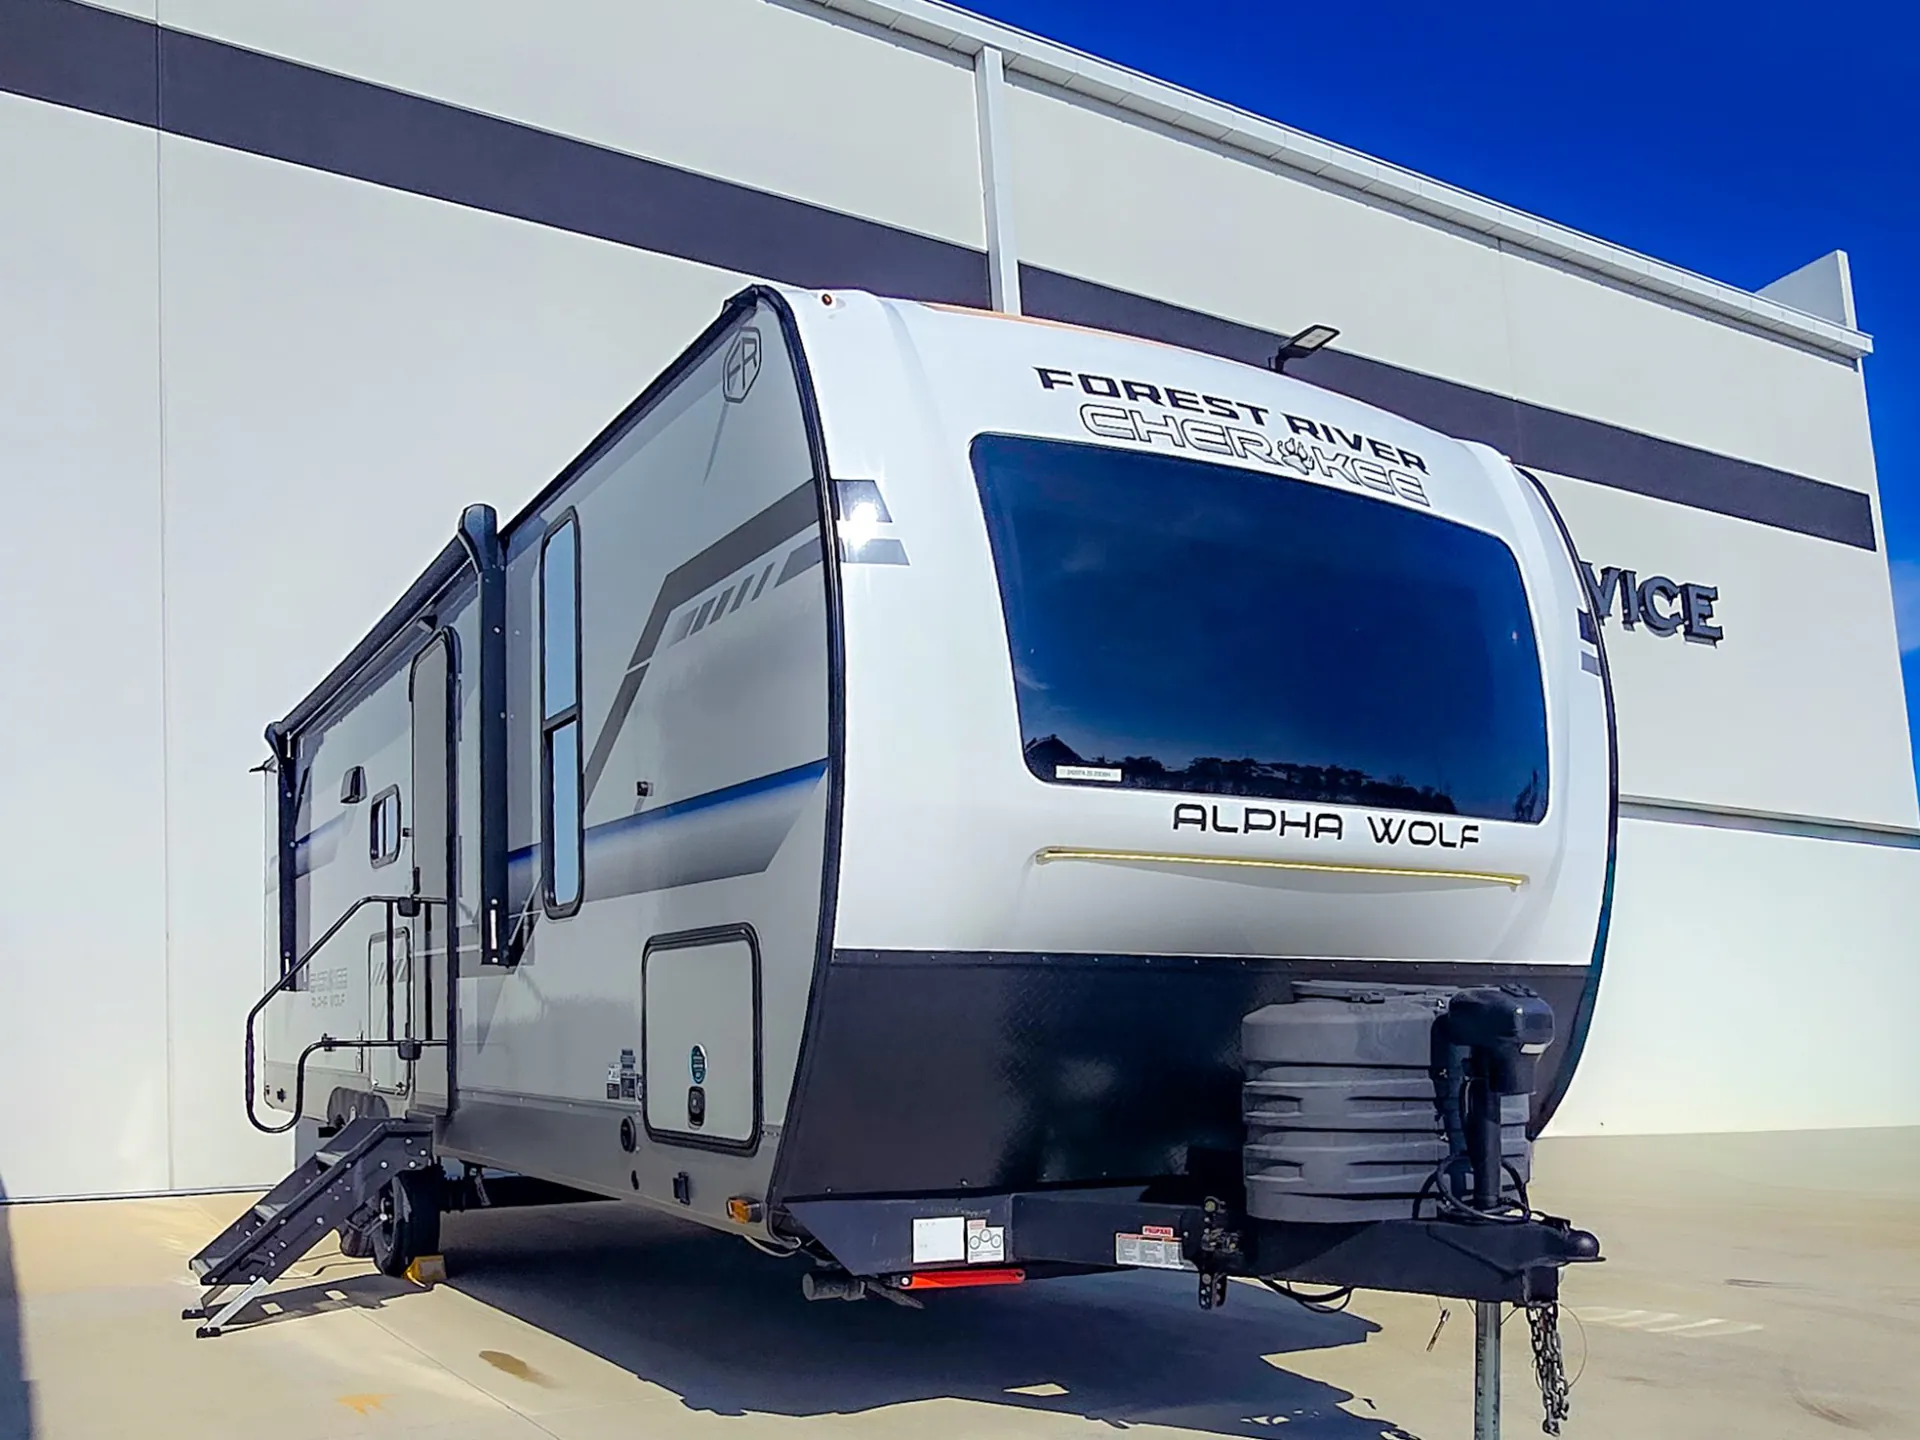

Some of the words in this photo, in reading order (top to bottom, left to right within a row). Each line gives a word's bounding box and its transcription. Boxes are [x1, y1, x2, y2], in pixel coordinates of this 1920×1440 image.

[1036, 367, 1269, 426] FOREST
[1280, 412, 1431, 476] RIVER
[1173, 803, 1343, 840] ALPHA
[1367, 816, 1480, 849] WOLF
